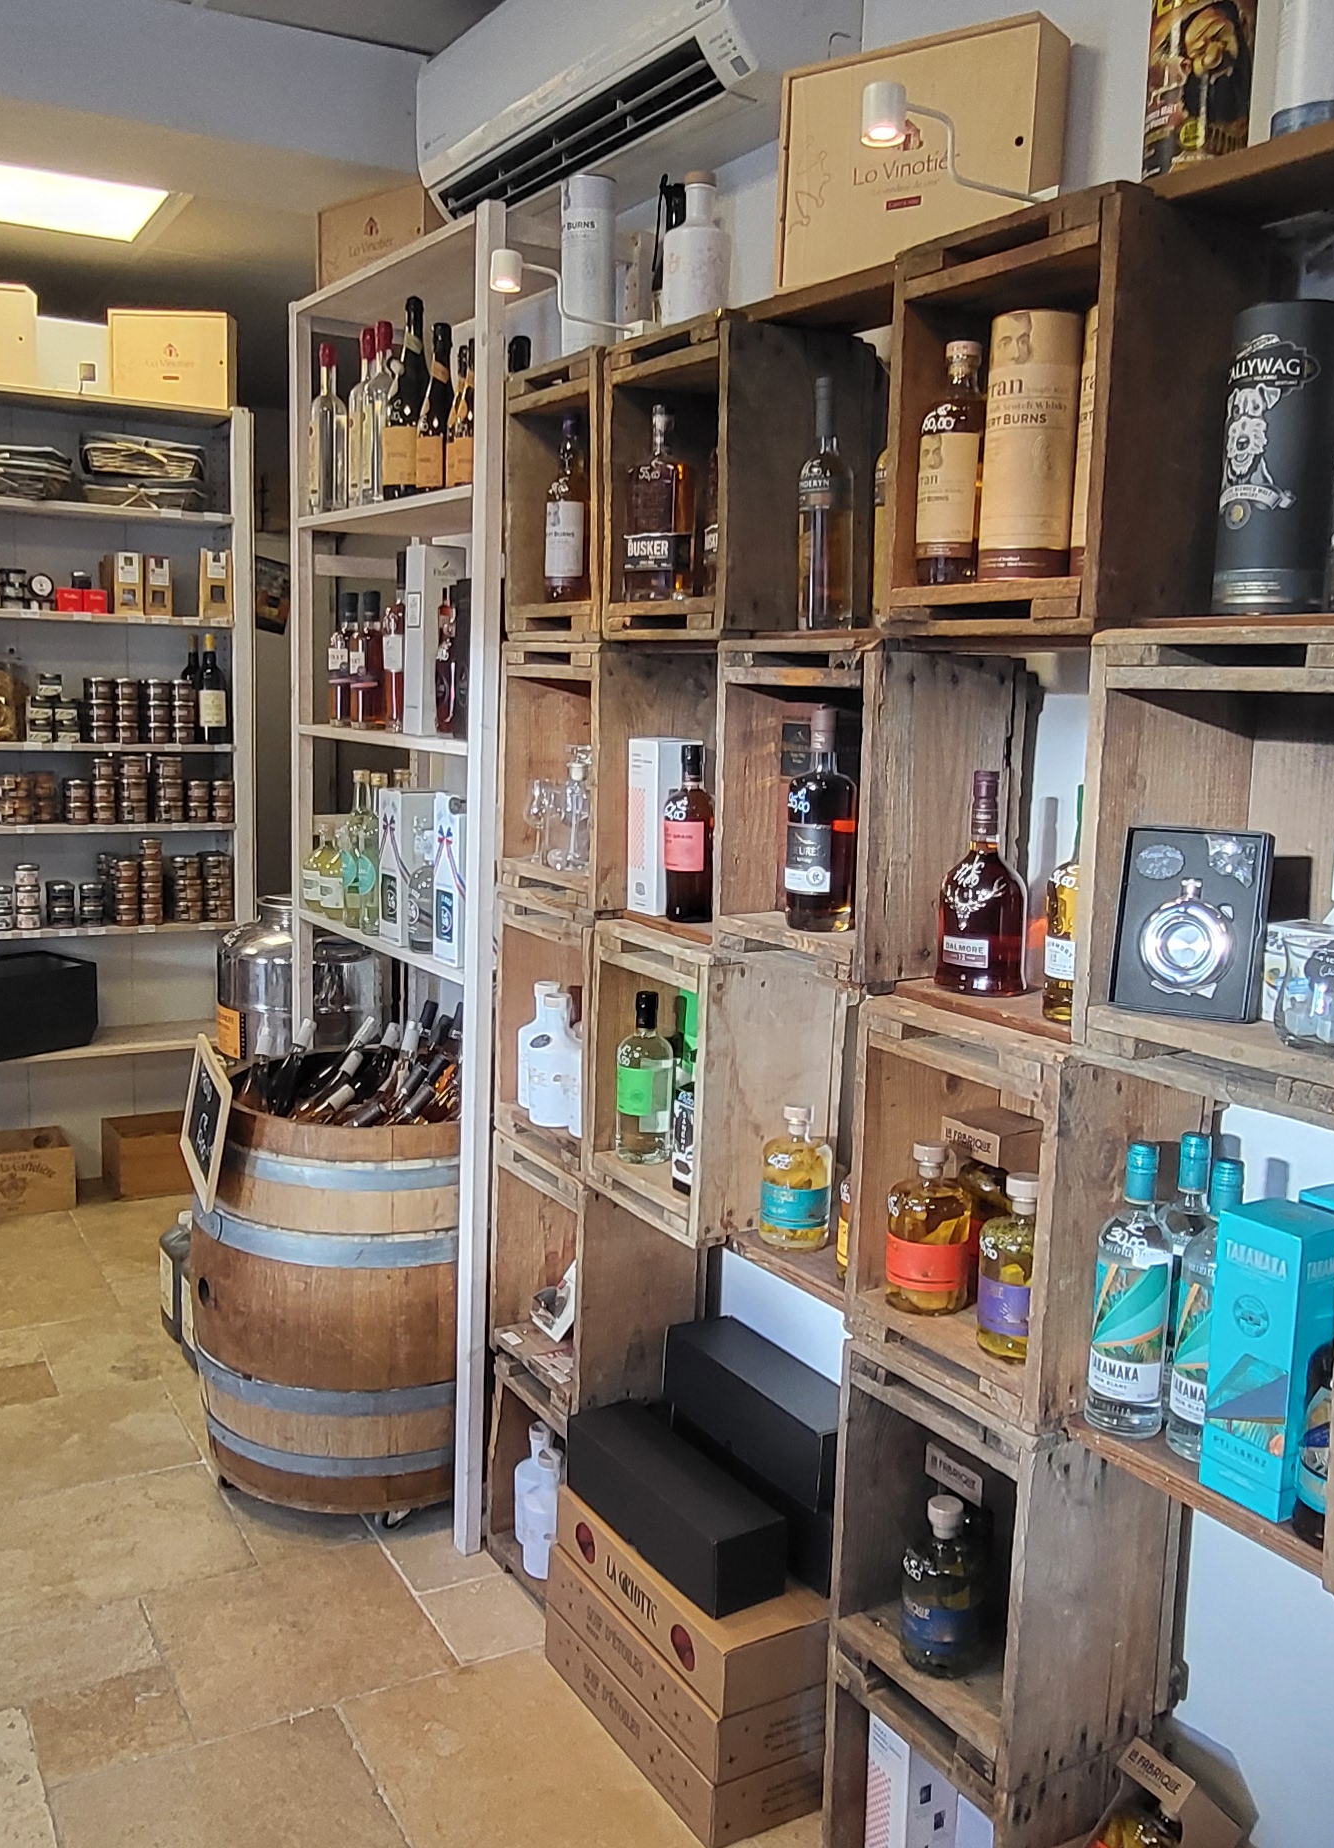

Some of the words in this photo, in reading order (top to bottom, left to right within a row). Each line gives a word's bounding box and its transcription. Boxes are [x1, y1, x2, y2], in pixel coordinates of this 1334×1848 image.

[853, 167, 878, 186] Lo
[1003, 413, 1048, 425] BURNS
[627, 539, 669, 557] BUSKER
[945, 942, 984, 955] DALMORE
[953, 1129, 992, 1153] FABRIQUE
[1226, 1239, 1288, 1281] TAKAMAKA
[938, 1460, 976, 1491] FABRIQUE
[606, 1554, 617, 1586] LA
[618, 1570, 658, 1628] GRIOTTE
[1137, 1755, 1182, 1796] FABRIQUE
